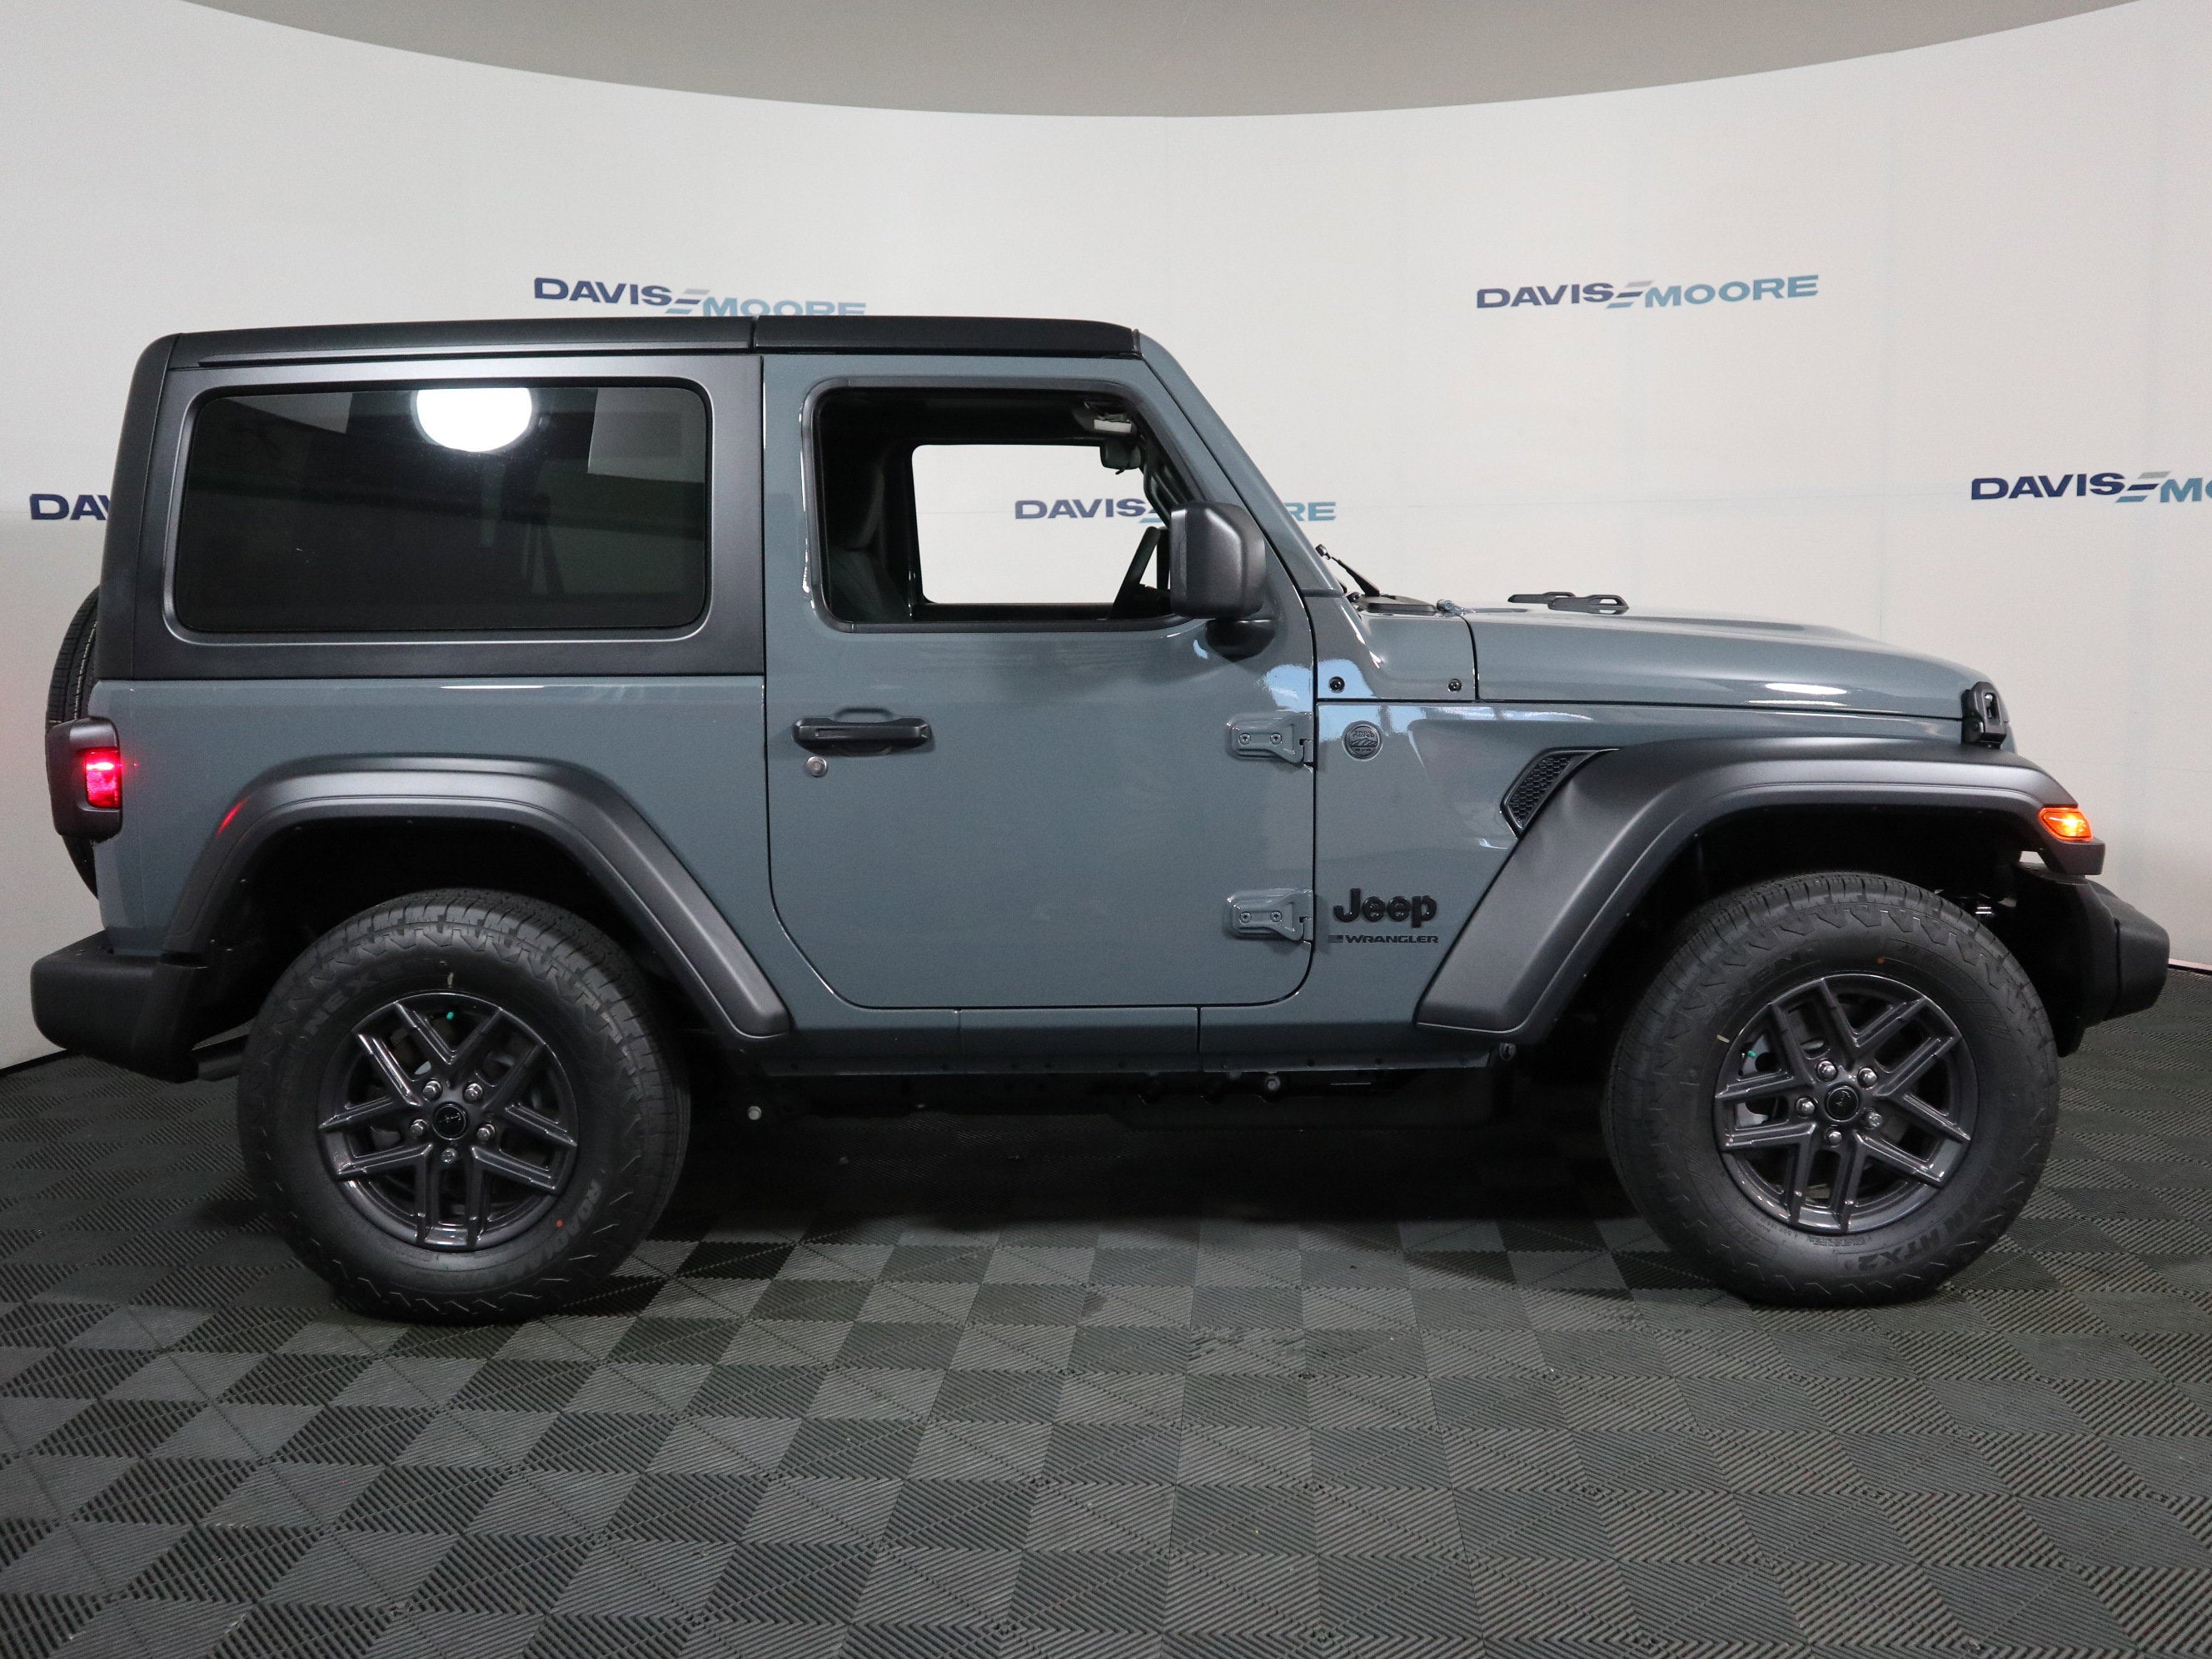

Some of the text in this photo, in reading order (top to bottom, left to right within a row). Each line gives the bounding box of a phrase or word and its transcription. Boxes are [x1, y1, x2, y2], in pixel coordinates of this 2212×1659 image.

[534, 277, 671, 306] DAVIS
[1477, 275, 1819, 308] DAVIS MOORE
[1971, 472, 2212, 502] DAVIS M
[1014, 498, 1146, 519] DAVIS
[1333, 888, 1437, 929] Jeep
[1345, 934, 1439, 944] WRANGLER
